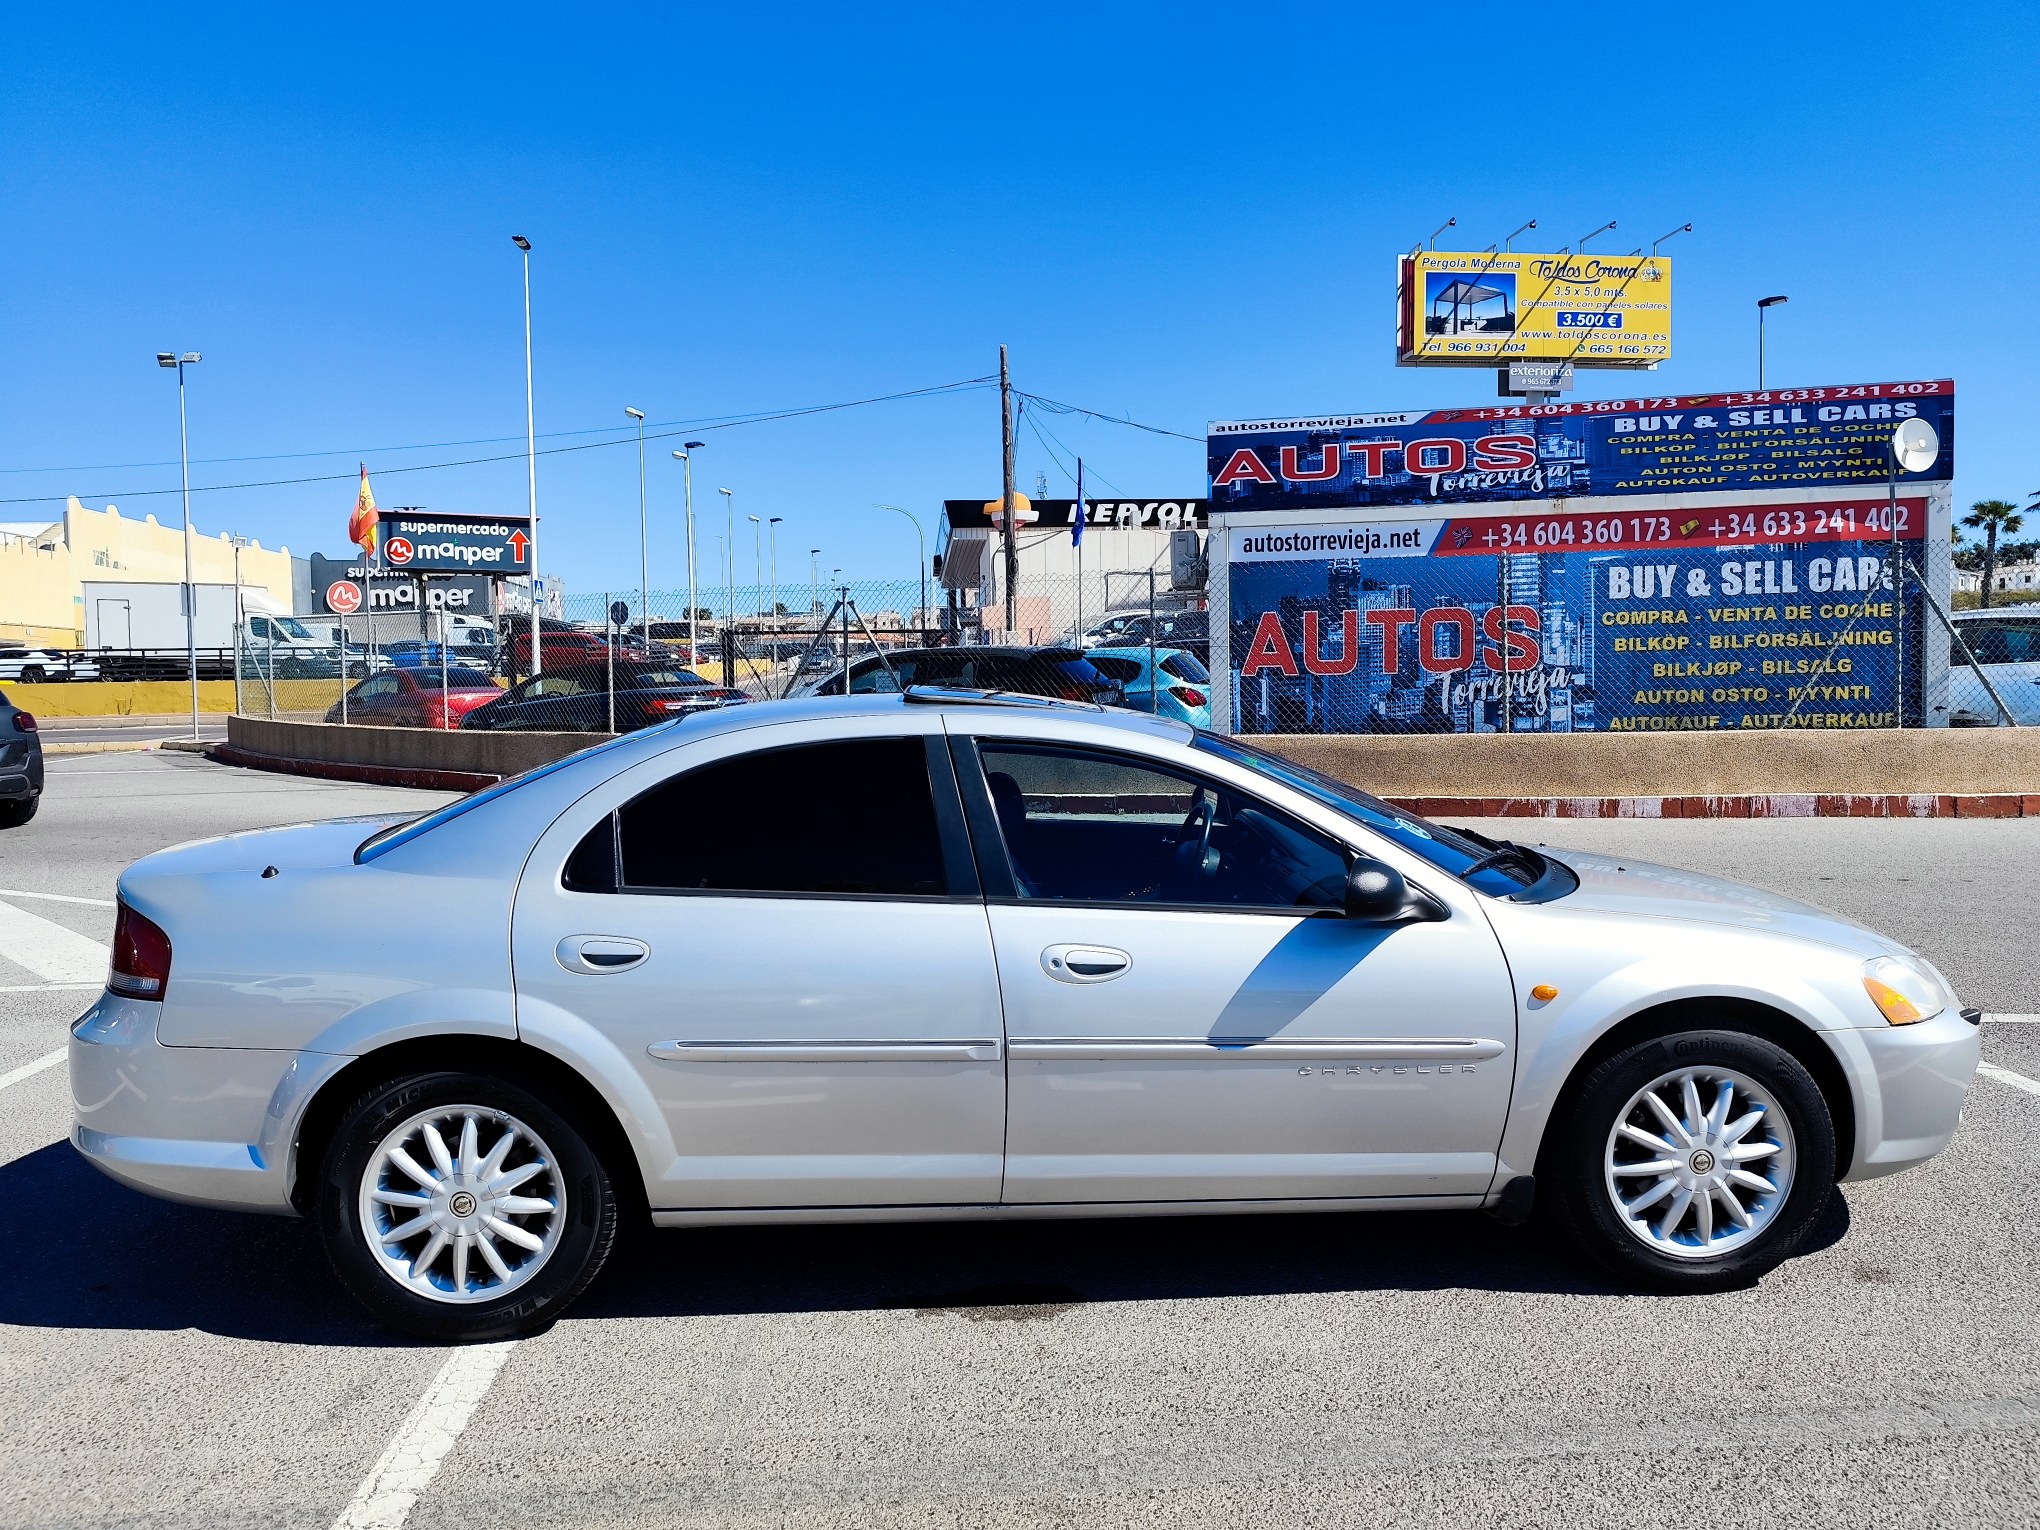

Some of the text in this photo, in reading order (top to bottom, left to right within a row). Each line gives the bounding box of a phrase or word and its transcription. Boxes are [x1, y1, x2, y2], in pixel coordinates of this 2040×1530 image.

[1422, 258, 1521, 269] Pérgola Moderna
[1529, 260, 1638, 281] Toldos Corona
[1554, 286, 1571, 297] 3,5
[1584, 287, 1601, 297] 5,0
[1603, 289, 1627, 297] mts.
[1521, 300, 1574, 309] Compatible
[1562, 313, 1619, 327] 3.500 €
[1521, 330, 1667, 341] www.toldoscorona.es
[1421, 342, 1526, 352] Tel. 966 931 004
[1589, 345, 1667, 355] 665 166 572
[1510, 365, 1573, 377] exterioriza
[1719, 383, 1940, 404] +34 633 241 402
[1473, 398, 1678, 419] +34 604 360 173
[1614, 402, 1918, 433] BUY & SELL CARS
[1215, 413, 1407, 433] autostorrevieja.net
[1607, 433, 1695, 444] COMPRA
[1715, 428, 1787, 439] VENTA
[1794, 426, 1822, 434] DE
[1829, 422, 1902, 433] COCHE
[1620, 443, 1697, 455] BILKÖP
[1717, 434, 1889, 450] BILFÖRSÄLJNIN
[1212, 434, 1537, 486] AUTOS
[1660, 453, 1750, 464] BILKJØP
[1771, 447, 1863, 458] BILSALG
[1640, 466, 1712, 476] AUTON
[1720, 462, 1777, 471] OSTO
[1798, 458, 1883, 469] MYYNTI
[1422, 463, 1571, 497] Torrevieja
[1615, 476, 1728, 488] AUTOKAUF
[1749, 468, 1910, 482] AUTOVERKAUF
[1067, 502, 1198, 523] REPSOL
[1708, 506, 1909, 539] +34 633 241 402
[400, 521, 509, 537] supermercado
[1482, 516, 1671, 548] +34 604 360 173
[1243, 528, 1421, 554] autostorrevieja.net
[418, 542, 504, 565] manper
[1608, 564, 1677, 599] BUY
[1686, 568, 1711, 597] &
[1720, 559, 1799, 596] SELL
[1602, 609, 1689, 626] COMPRA
[1707, 606, 1777, 622] VENTA
[1784, 605, 1812, 620] DE
[1241, 604, 1541, 677] AUTOS
[1614, 634, 1690, 652] BILKÖP
[1709, 629, 1894, 649] BILFÖRSÄLJNING
[1653, 661, 1743, 678] BILKJØP
[1762, 658, 1852, 675] BILSALG
[1421, 665, 1573, 716] Torrevieja
[1633, 688, 1705, 704] AUTON
[1711, 687, 1768, 703] OSTO
[1788, 685, 1870, 701] MYYNTI
[1609, 714, 1720, 731] AUTOKAUF
[1740, 711, 1894, 728] AUTOVERKAUF
[1297, 1064, 1477, 1076] CHRYSLER
